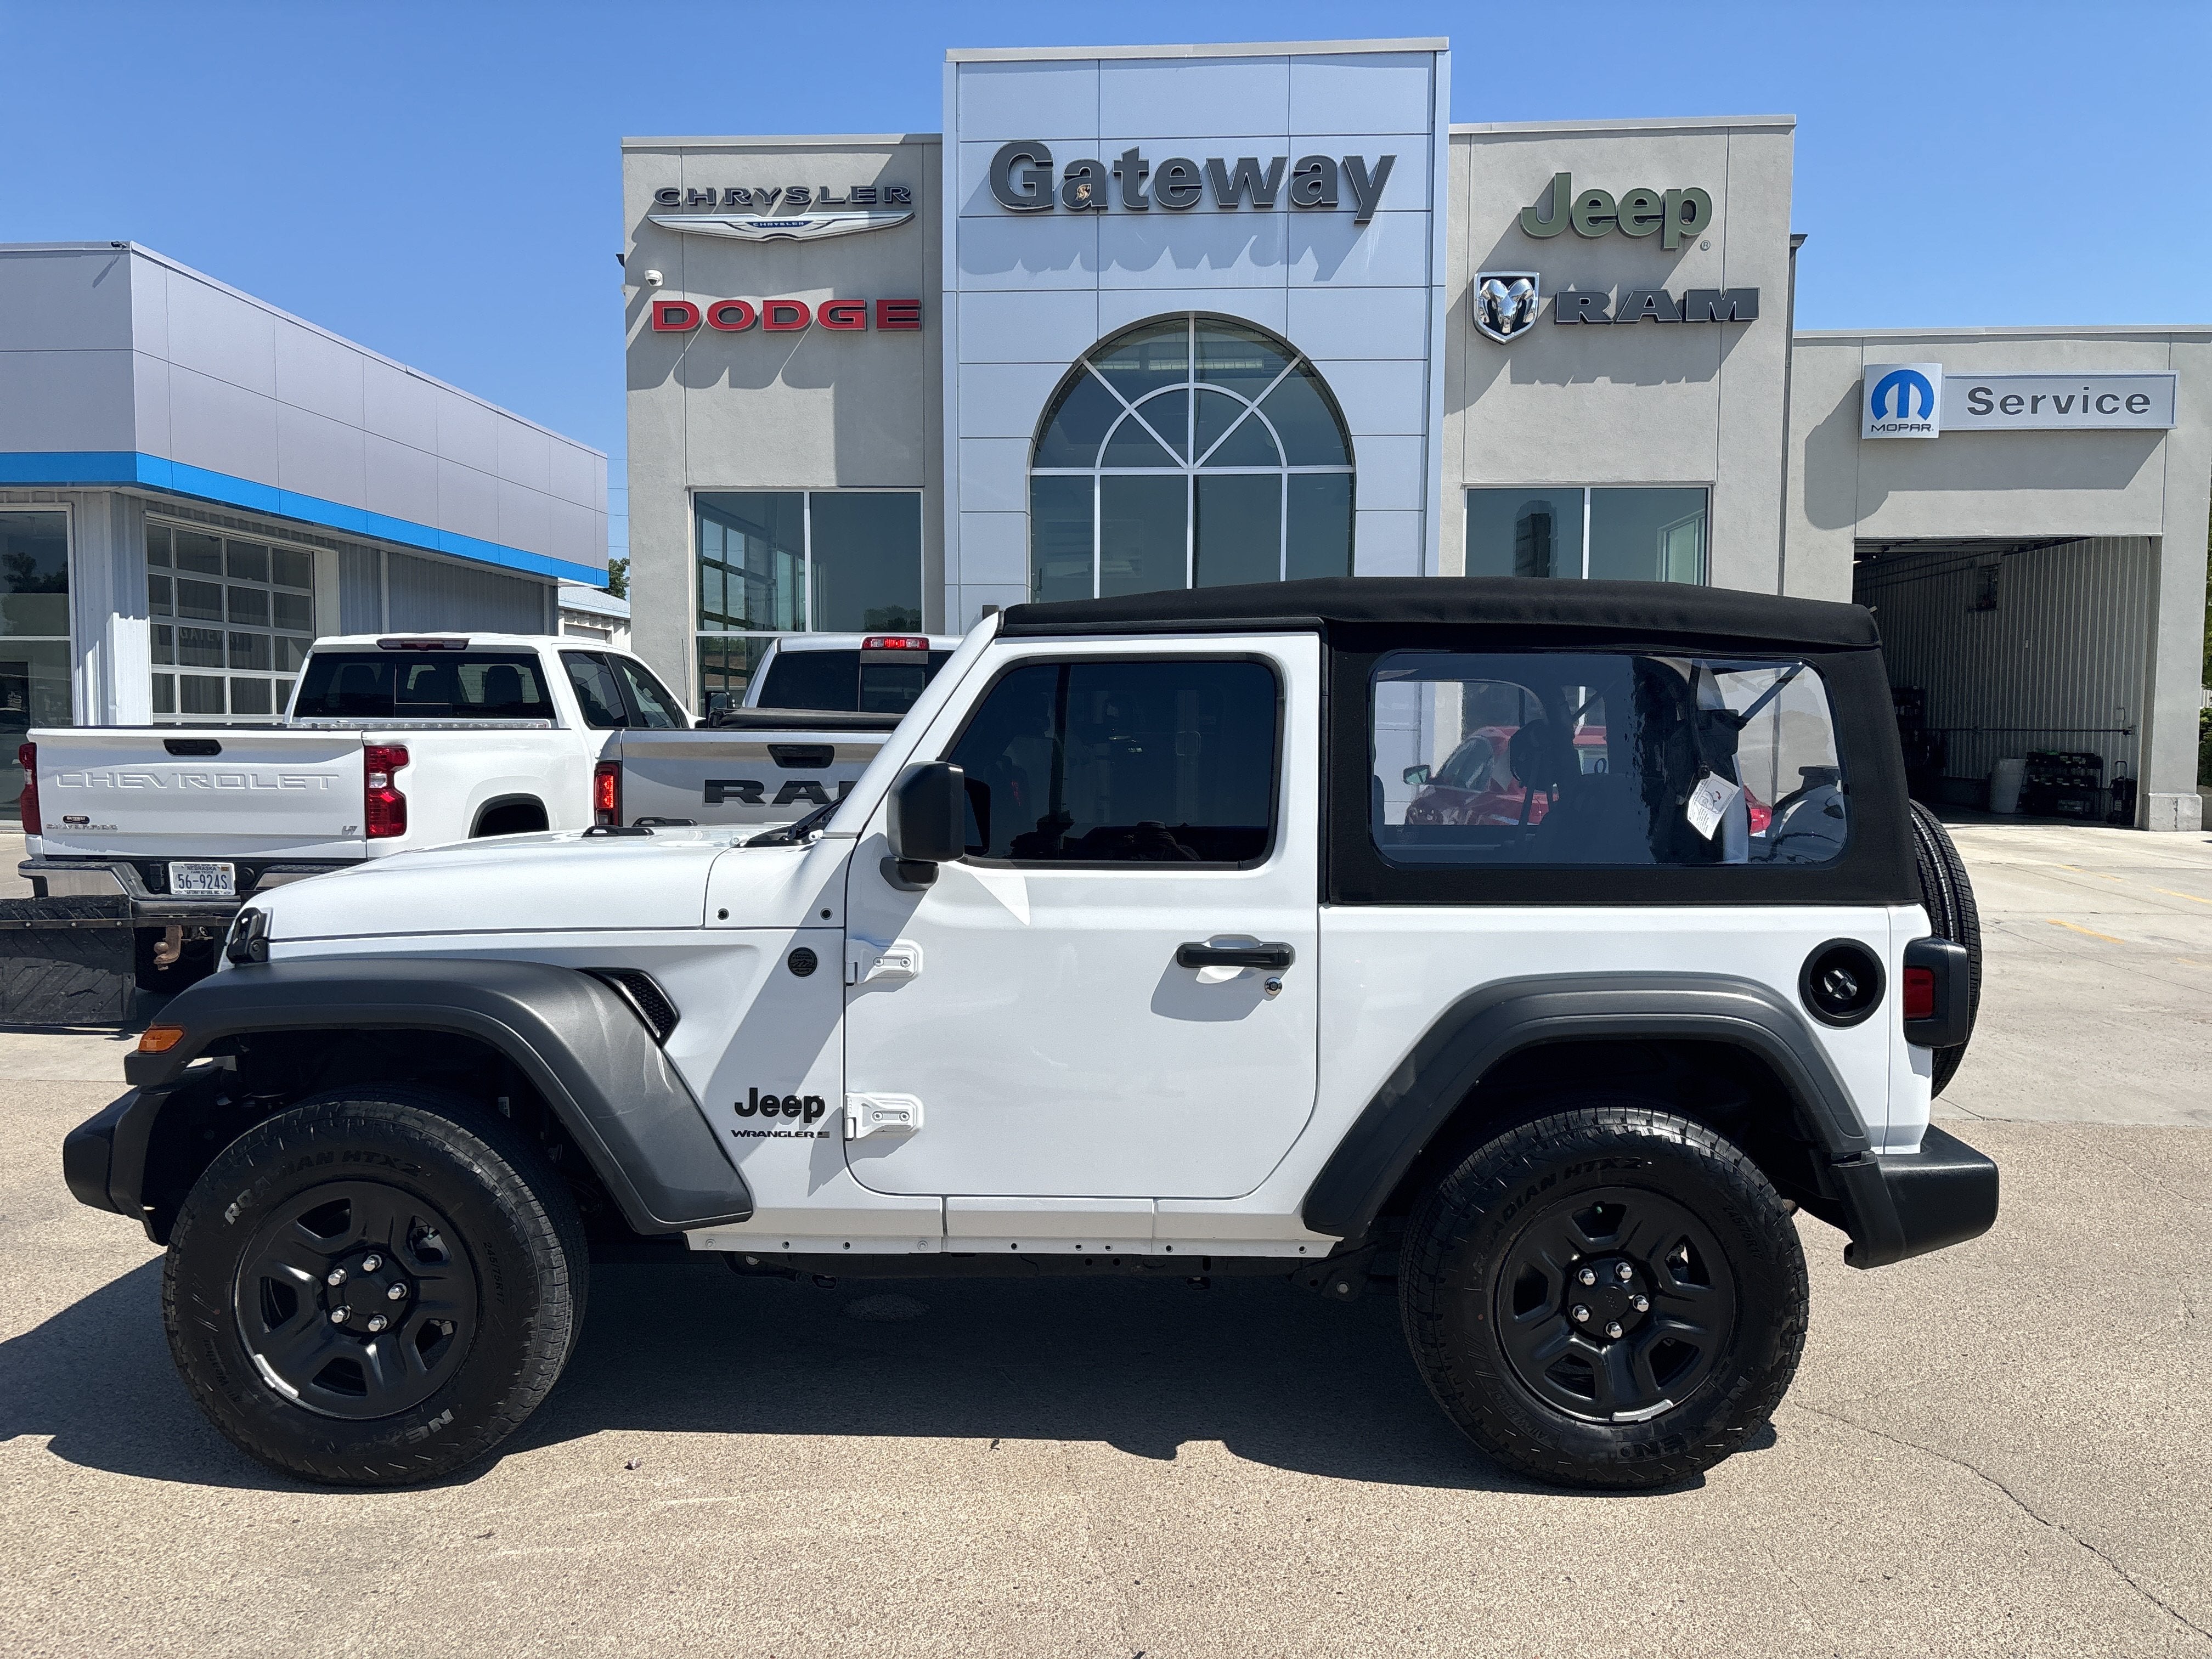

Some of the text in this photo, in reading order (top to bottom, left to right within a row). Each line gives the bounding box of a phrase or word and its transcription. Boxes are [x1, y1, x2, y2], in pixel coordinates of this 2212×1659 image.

[653, 185, 911, 206] CHRYSLER
[988, 140, 1397, 224] Gateway
[1520, 172, 1713, 251] Jeep
[652, 298, 922, 332] DODGE
[1554, 287, 1760, 324] RAM
[1967, 386, 2151, 416] Service
[1871, 424, 1932, 432] MOPAR
[56, 772, 340, 789] CHEVROLET
[177, 873, 228, 890] 56-924S
[734, 1087, 826, 1124] Jeep
[731, 1130, 815, 1138] WRANGLER
